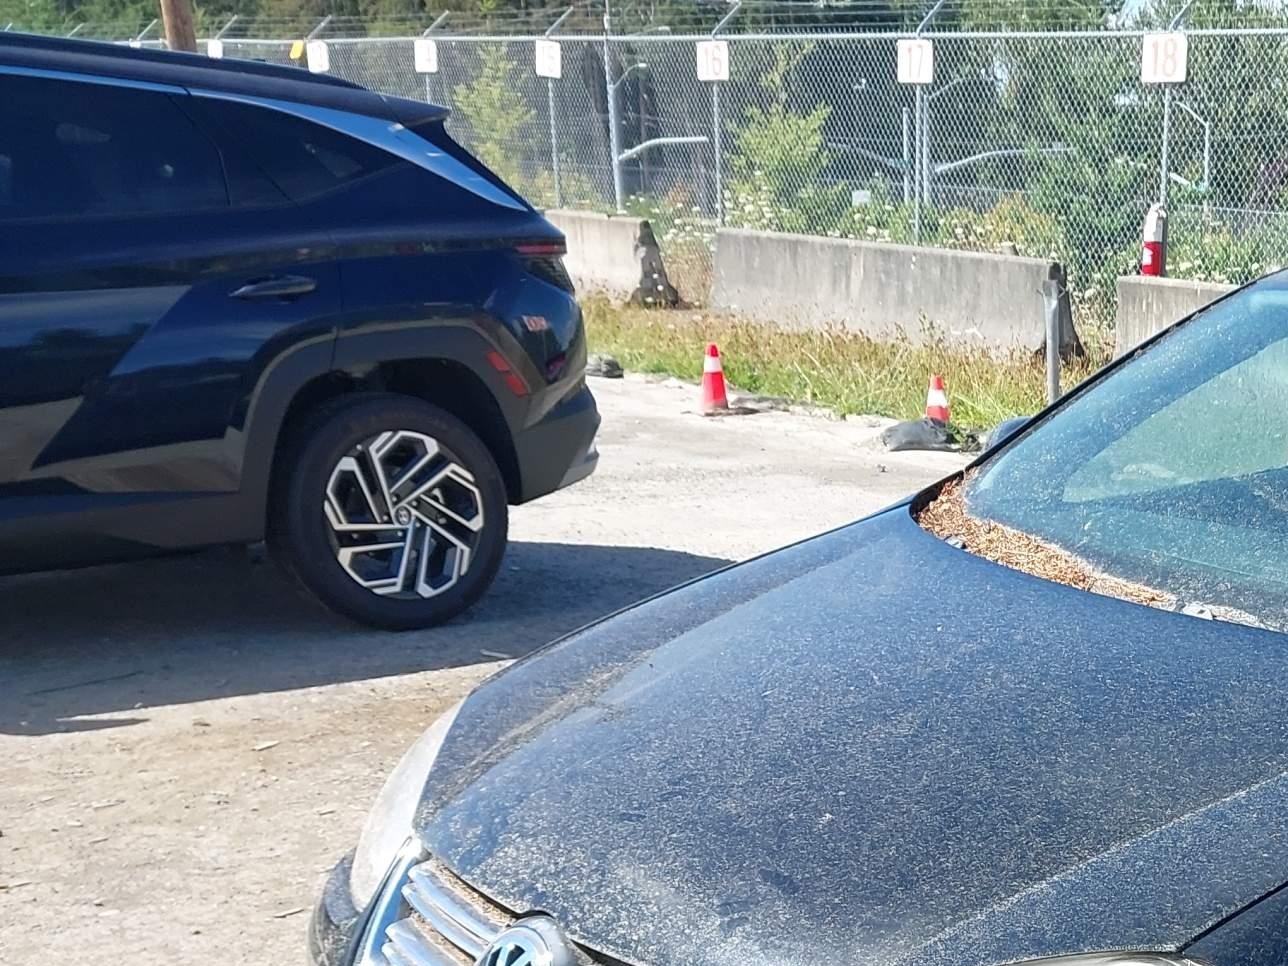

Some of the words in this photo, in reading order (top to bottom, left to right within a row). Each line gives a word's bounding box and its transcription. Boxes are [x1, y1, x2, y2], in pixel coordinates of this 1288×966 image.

[703, 44, 722, 76] 16
[907, 44, 923, 79] 17
[1152, 38, 1178, 77] 18
